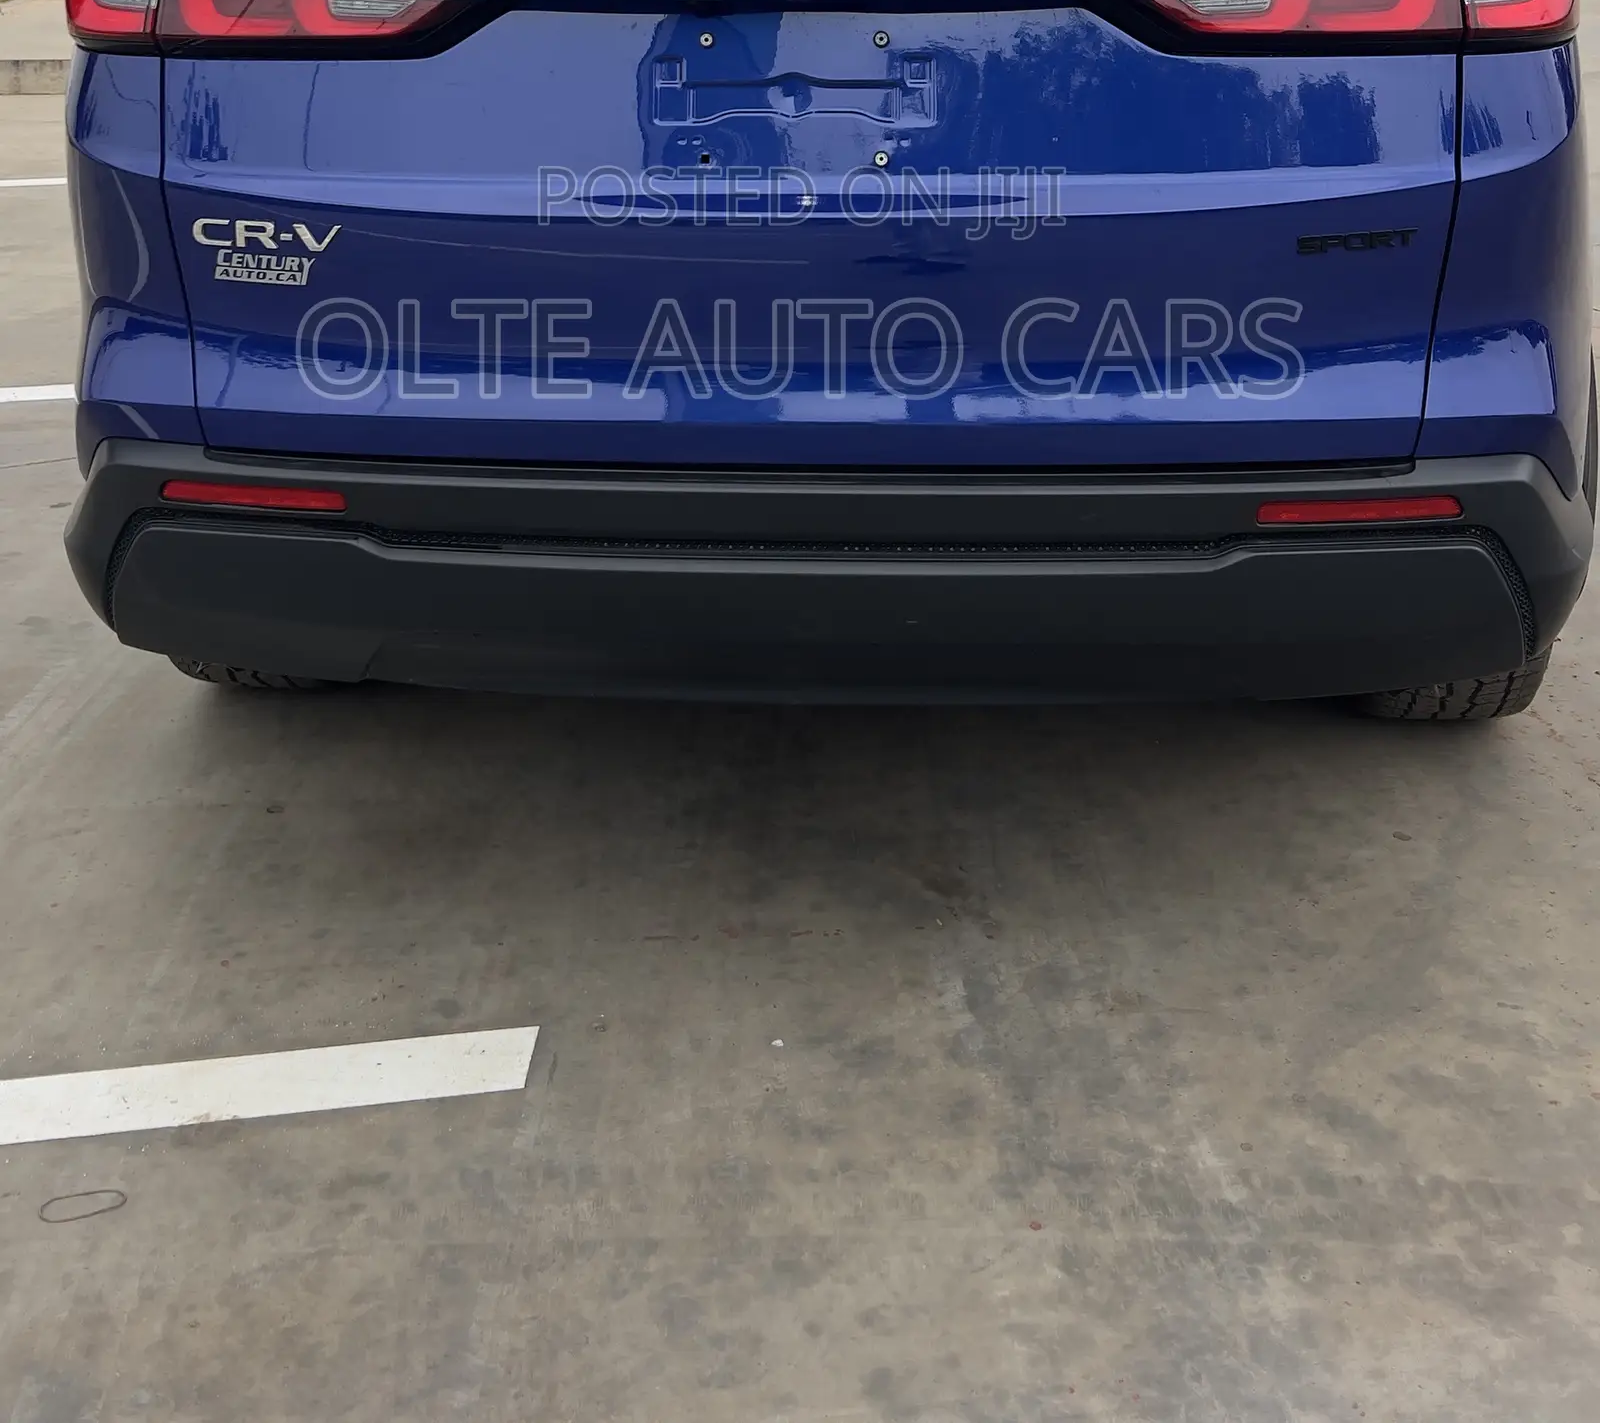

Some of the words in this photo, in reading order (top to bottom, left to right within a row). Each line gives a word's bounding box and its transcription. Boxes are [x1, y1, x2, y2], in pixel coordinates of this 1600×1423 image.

[192, 218, 342, 252] CR-V
[1297, 227, 1419, 254] SPORT
[216, 248, 316, 286] CENTURY
[218, 267, 299, 283] AUTO.CA
